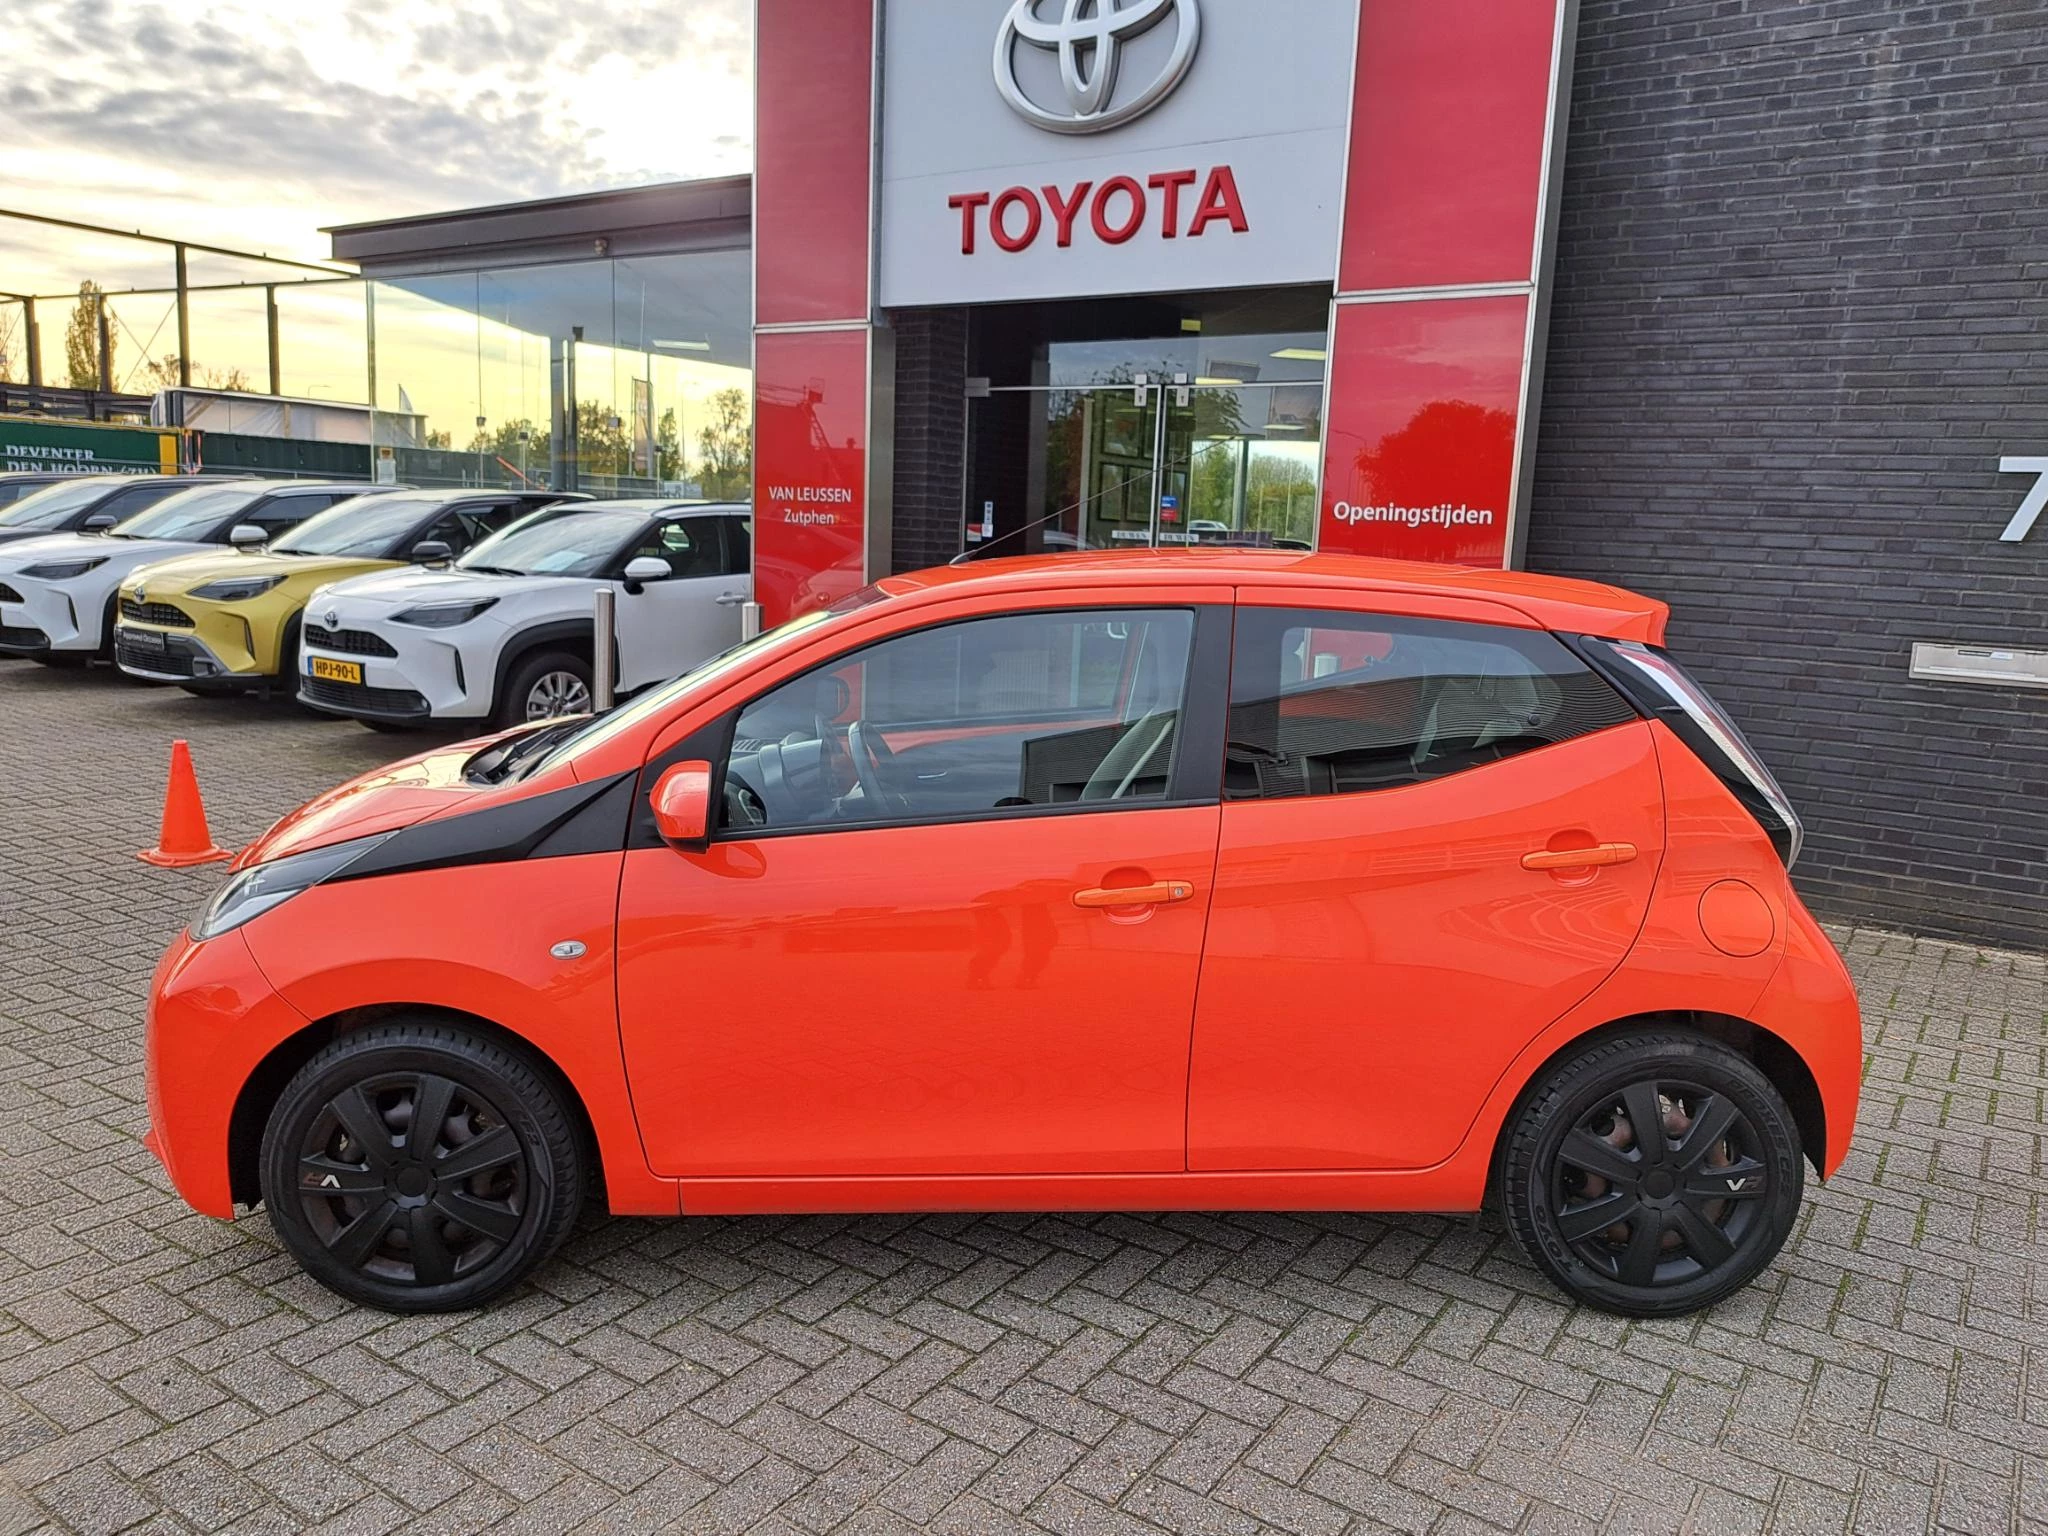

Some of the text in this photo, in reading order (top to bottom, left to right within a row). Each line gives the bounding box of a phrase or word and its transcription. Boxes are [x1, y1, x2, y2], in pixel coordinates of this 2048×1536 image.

[948, 165, 1249, 255] TOYOTA
[5, 444, 95, 461] DEVENTER
[7, 461, 43, 472] DEN
[768, 486, 852, 503] VAN LEUSSEN
[1999, 456, 2048, 541] 7
[784, 508, 834, 526] Zutphen
[1333, 501, 1493, 528] Openingstijden
[315, 660, 358, 681] HPJ-90-L
